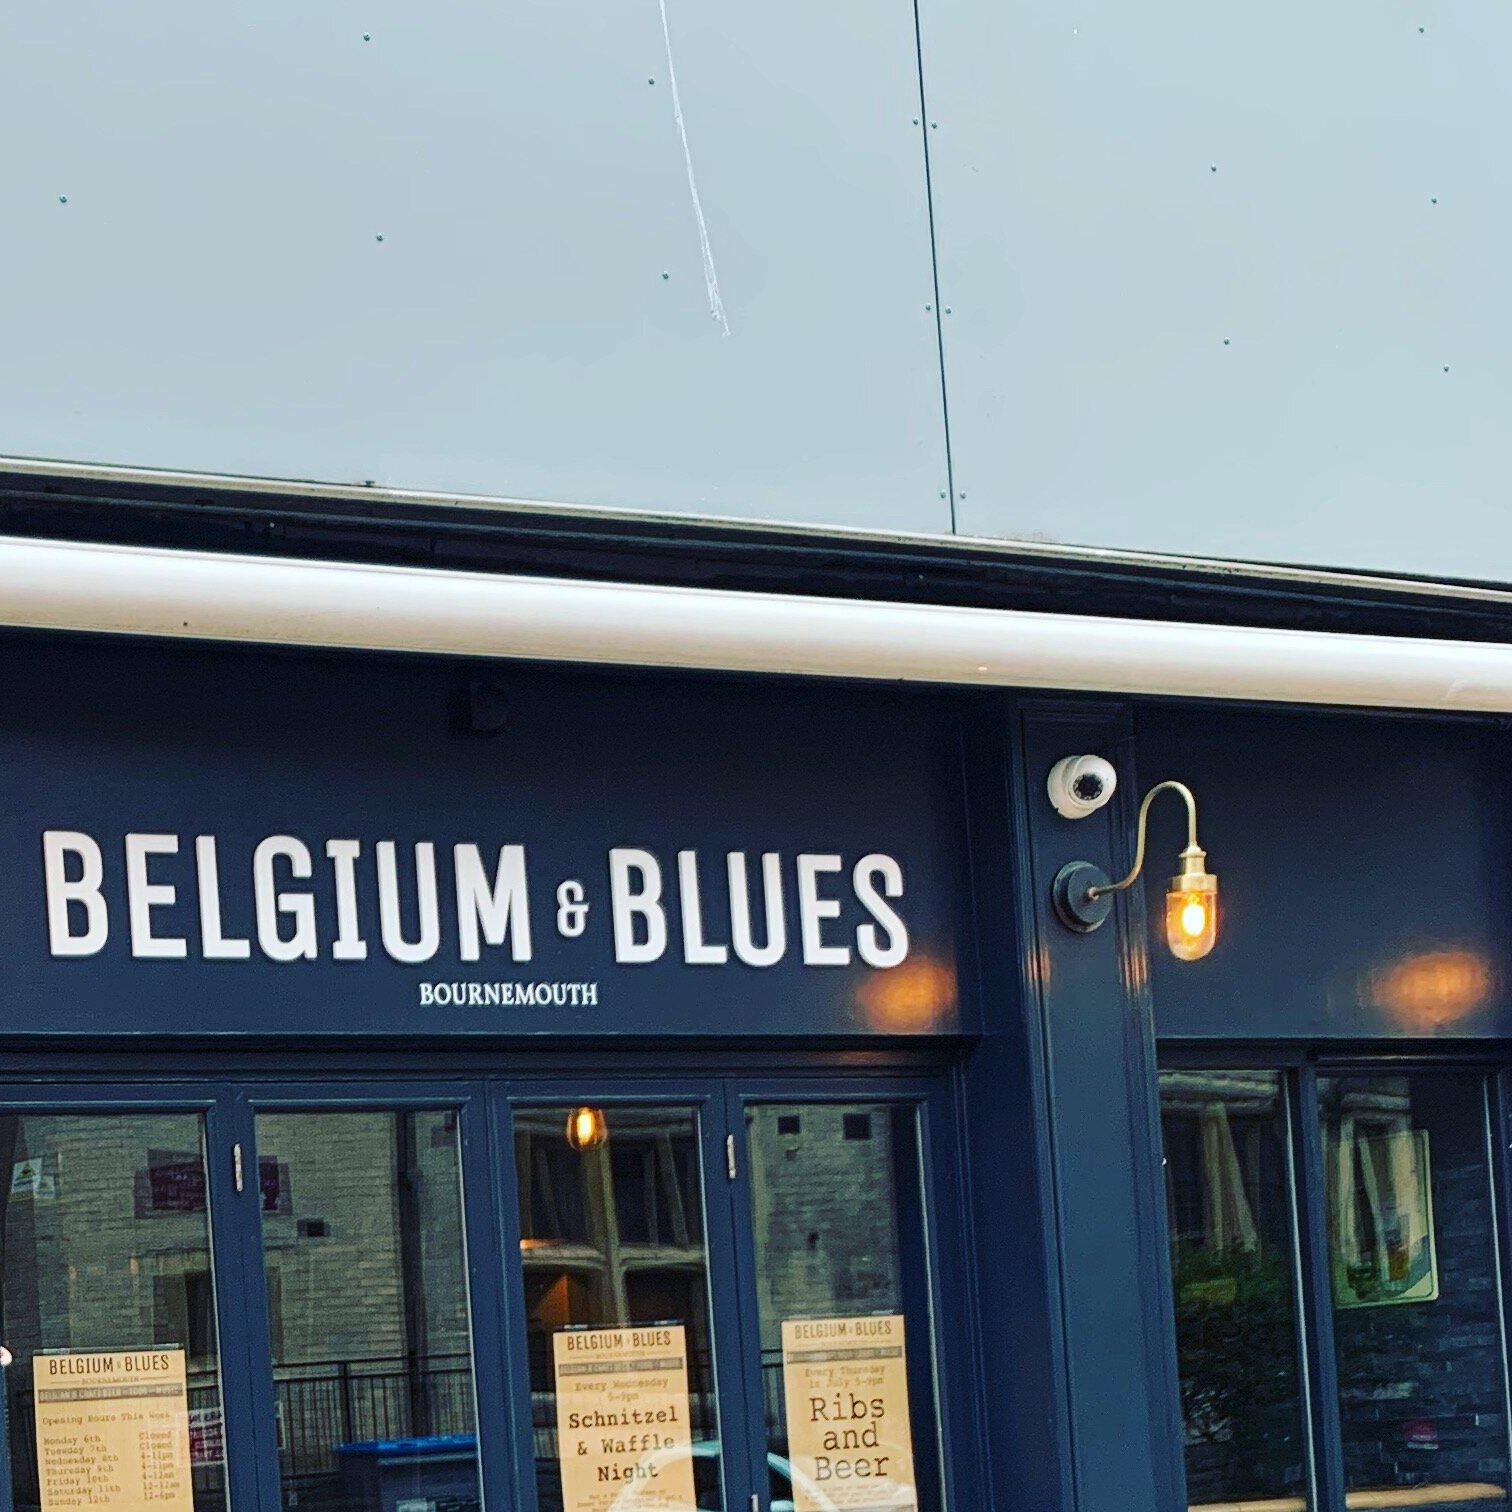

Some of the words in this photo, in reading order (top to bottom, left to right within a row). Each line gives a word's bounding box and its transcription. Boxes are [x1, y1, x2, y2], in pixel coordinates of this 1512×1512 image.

[43, 830, 532, 963] BELGIUM
[557, 880, 589, 937] &
[609, 847, 909, 969] BLUES
[419, 981, 598, 1007] BOURNEMOUTH
[794, 1323, 846, 1339] BELGIUM
[855, 1320, 892, 1335] BLUES
[567, 1334, 623, 1351] BELGIUM
[632, 1330, 671, 1346] BLUES
[49, 1357, 113, 1375] BELGIUM
[125, 1355, 169, 1372] BLUES
[575, 1382, 607, 1392] Every
[809, 1392, 885, 1422] Ribs
[43, 1416, 82, 1426] Opening
[121, 1413, 143, 1421] This
[569, 1406, 678, 1429] Schnitzel
[44, 1437, 78, 1446] Monday
[83, 1434, 101, 1443] 6th
[139, 1431, 172, 1440] Closed
[577, 1441, 588, 1456] &
[601, 1434, 676, 1454] Waffle
[823, 1421, 879, 1451] and
[44, 1446, 84, 1456] Tuesday
[139, 1441, 172, 1450] Closed
[45, 1456, 96, 1466] Wednesday
[814, 1456, 889, 1481] Beer
[46, 1466, 91, 1476] Thursday
[597, 1463, 659, 1484] Night
[47, 1477, 80, 1487] Friday
[87, 1475, 108, 1484] 10th
[47, 1486, 93, 1497] Saturday
[99, 1485, 121, 1494] 11th
[48, 1497, 82, 1506] Sunday
[88, 1496, 110, 1505] 12th
